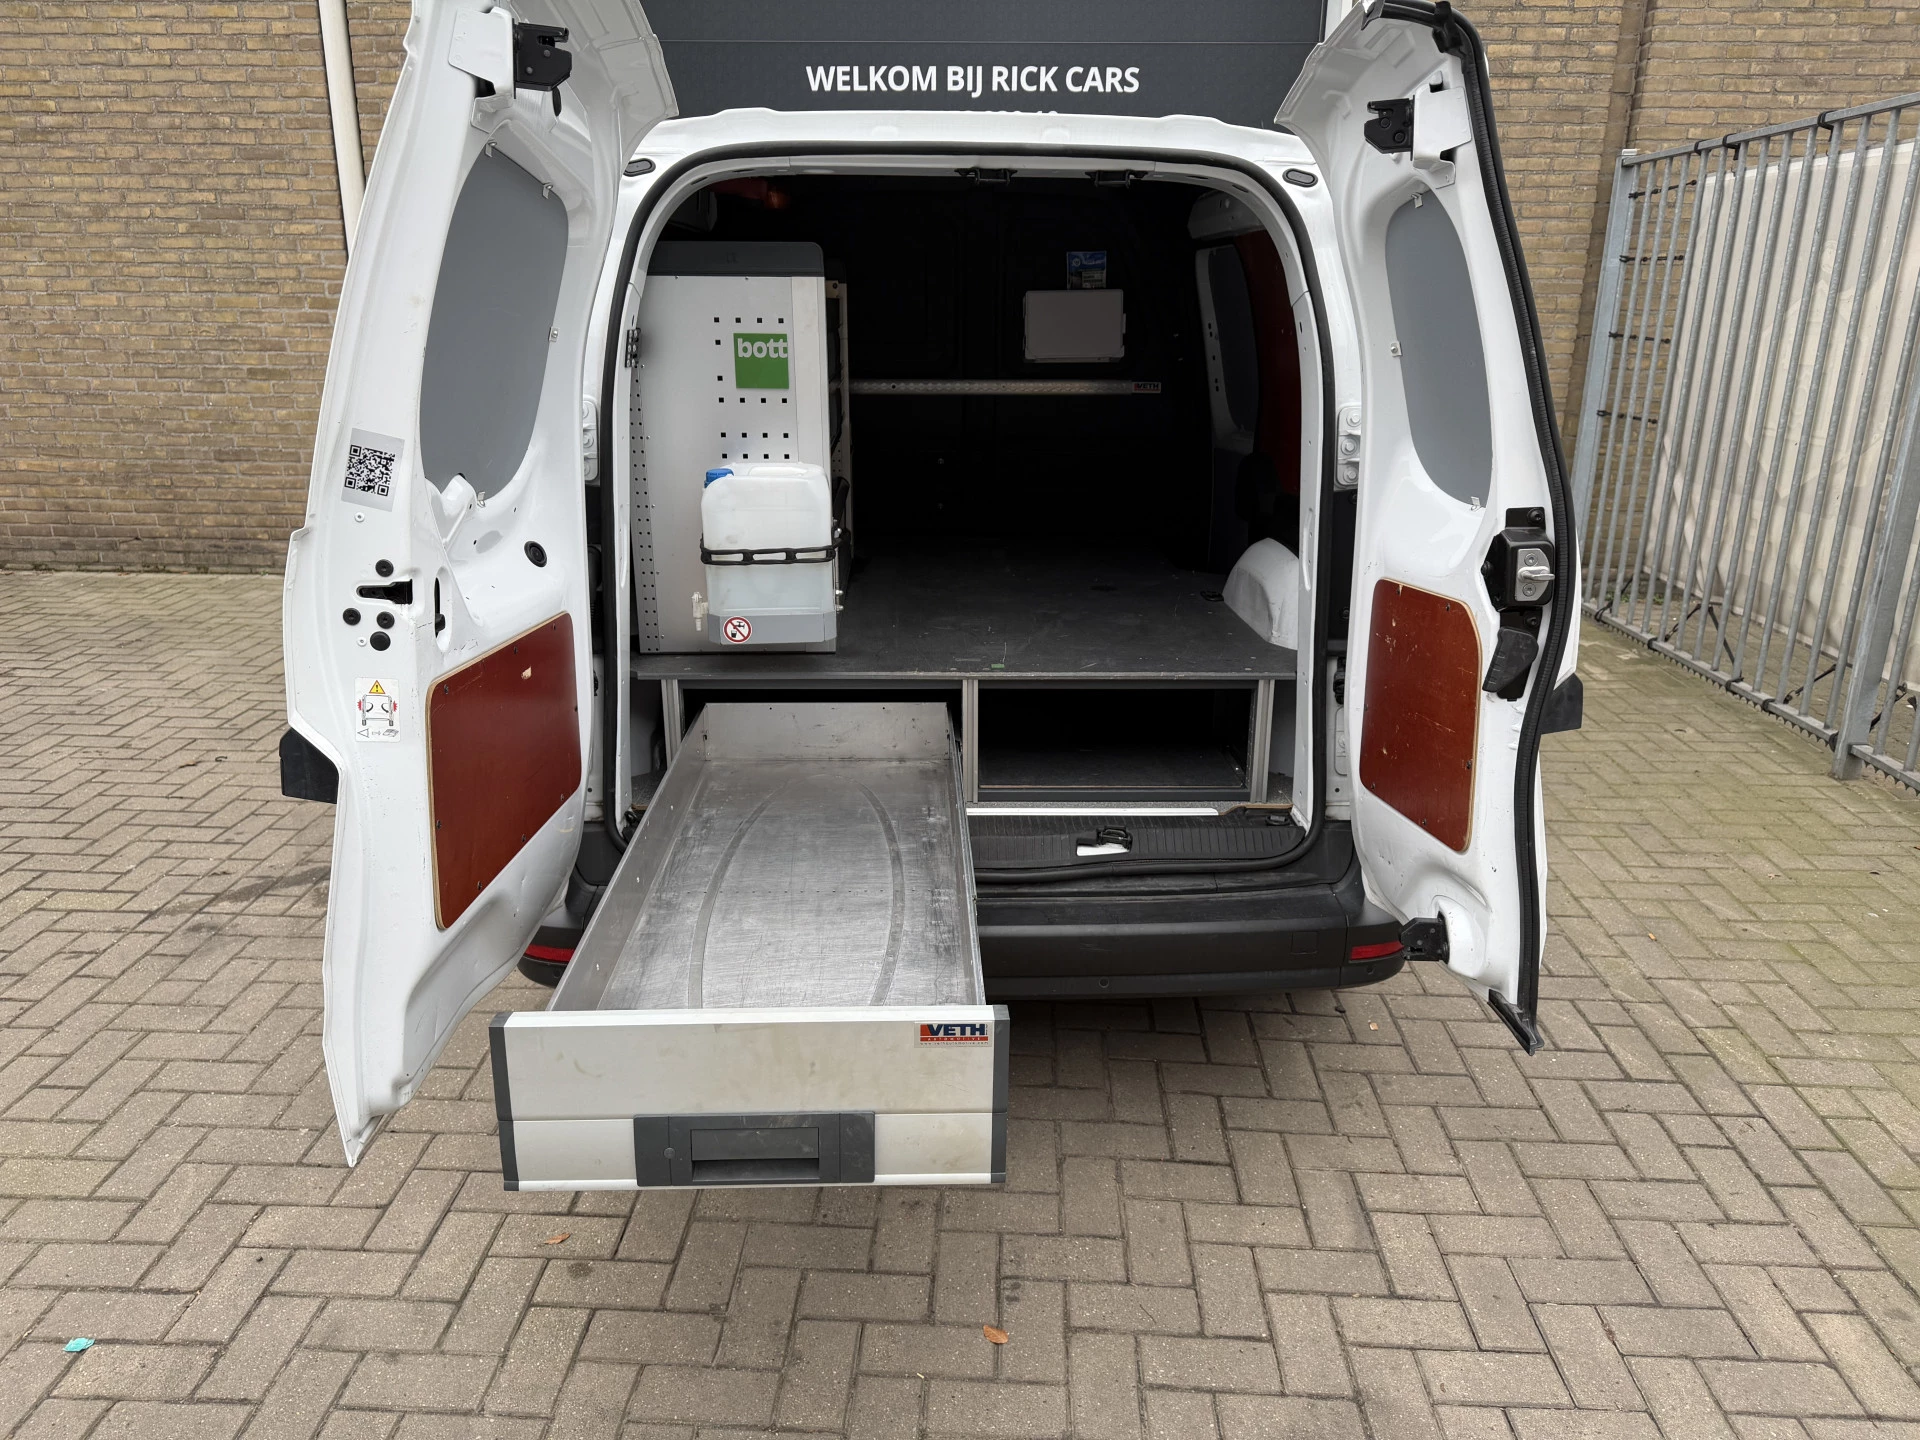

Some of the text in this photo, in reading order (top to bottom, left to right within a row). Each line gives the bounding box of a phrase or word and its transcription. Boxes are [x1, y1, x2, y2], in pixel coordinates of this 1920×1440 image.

[805, 65, 1140, 98] WELKOM BIJ RICK CARS
[737, 338, 788, 358] bott
[927, 1024, 985, 1036] VETH
